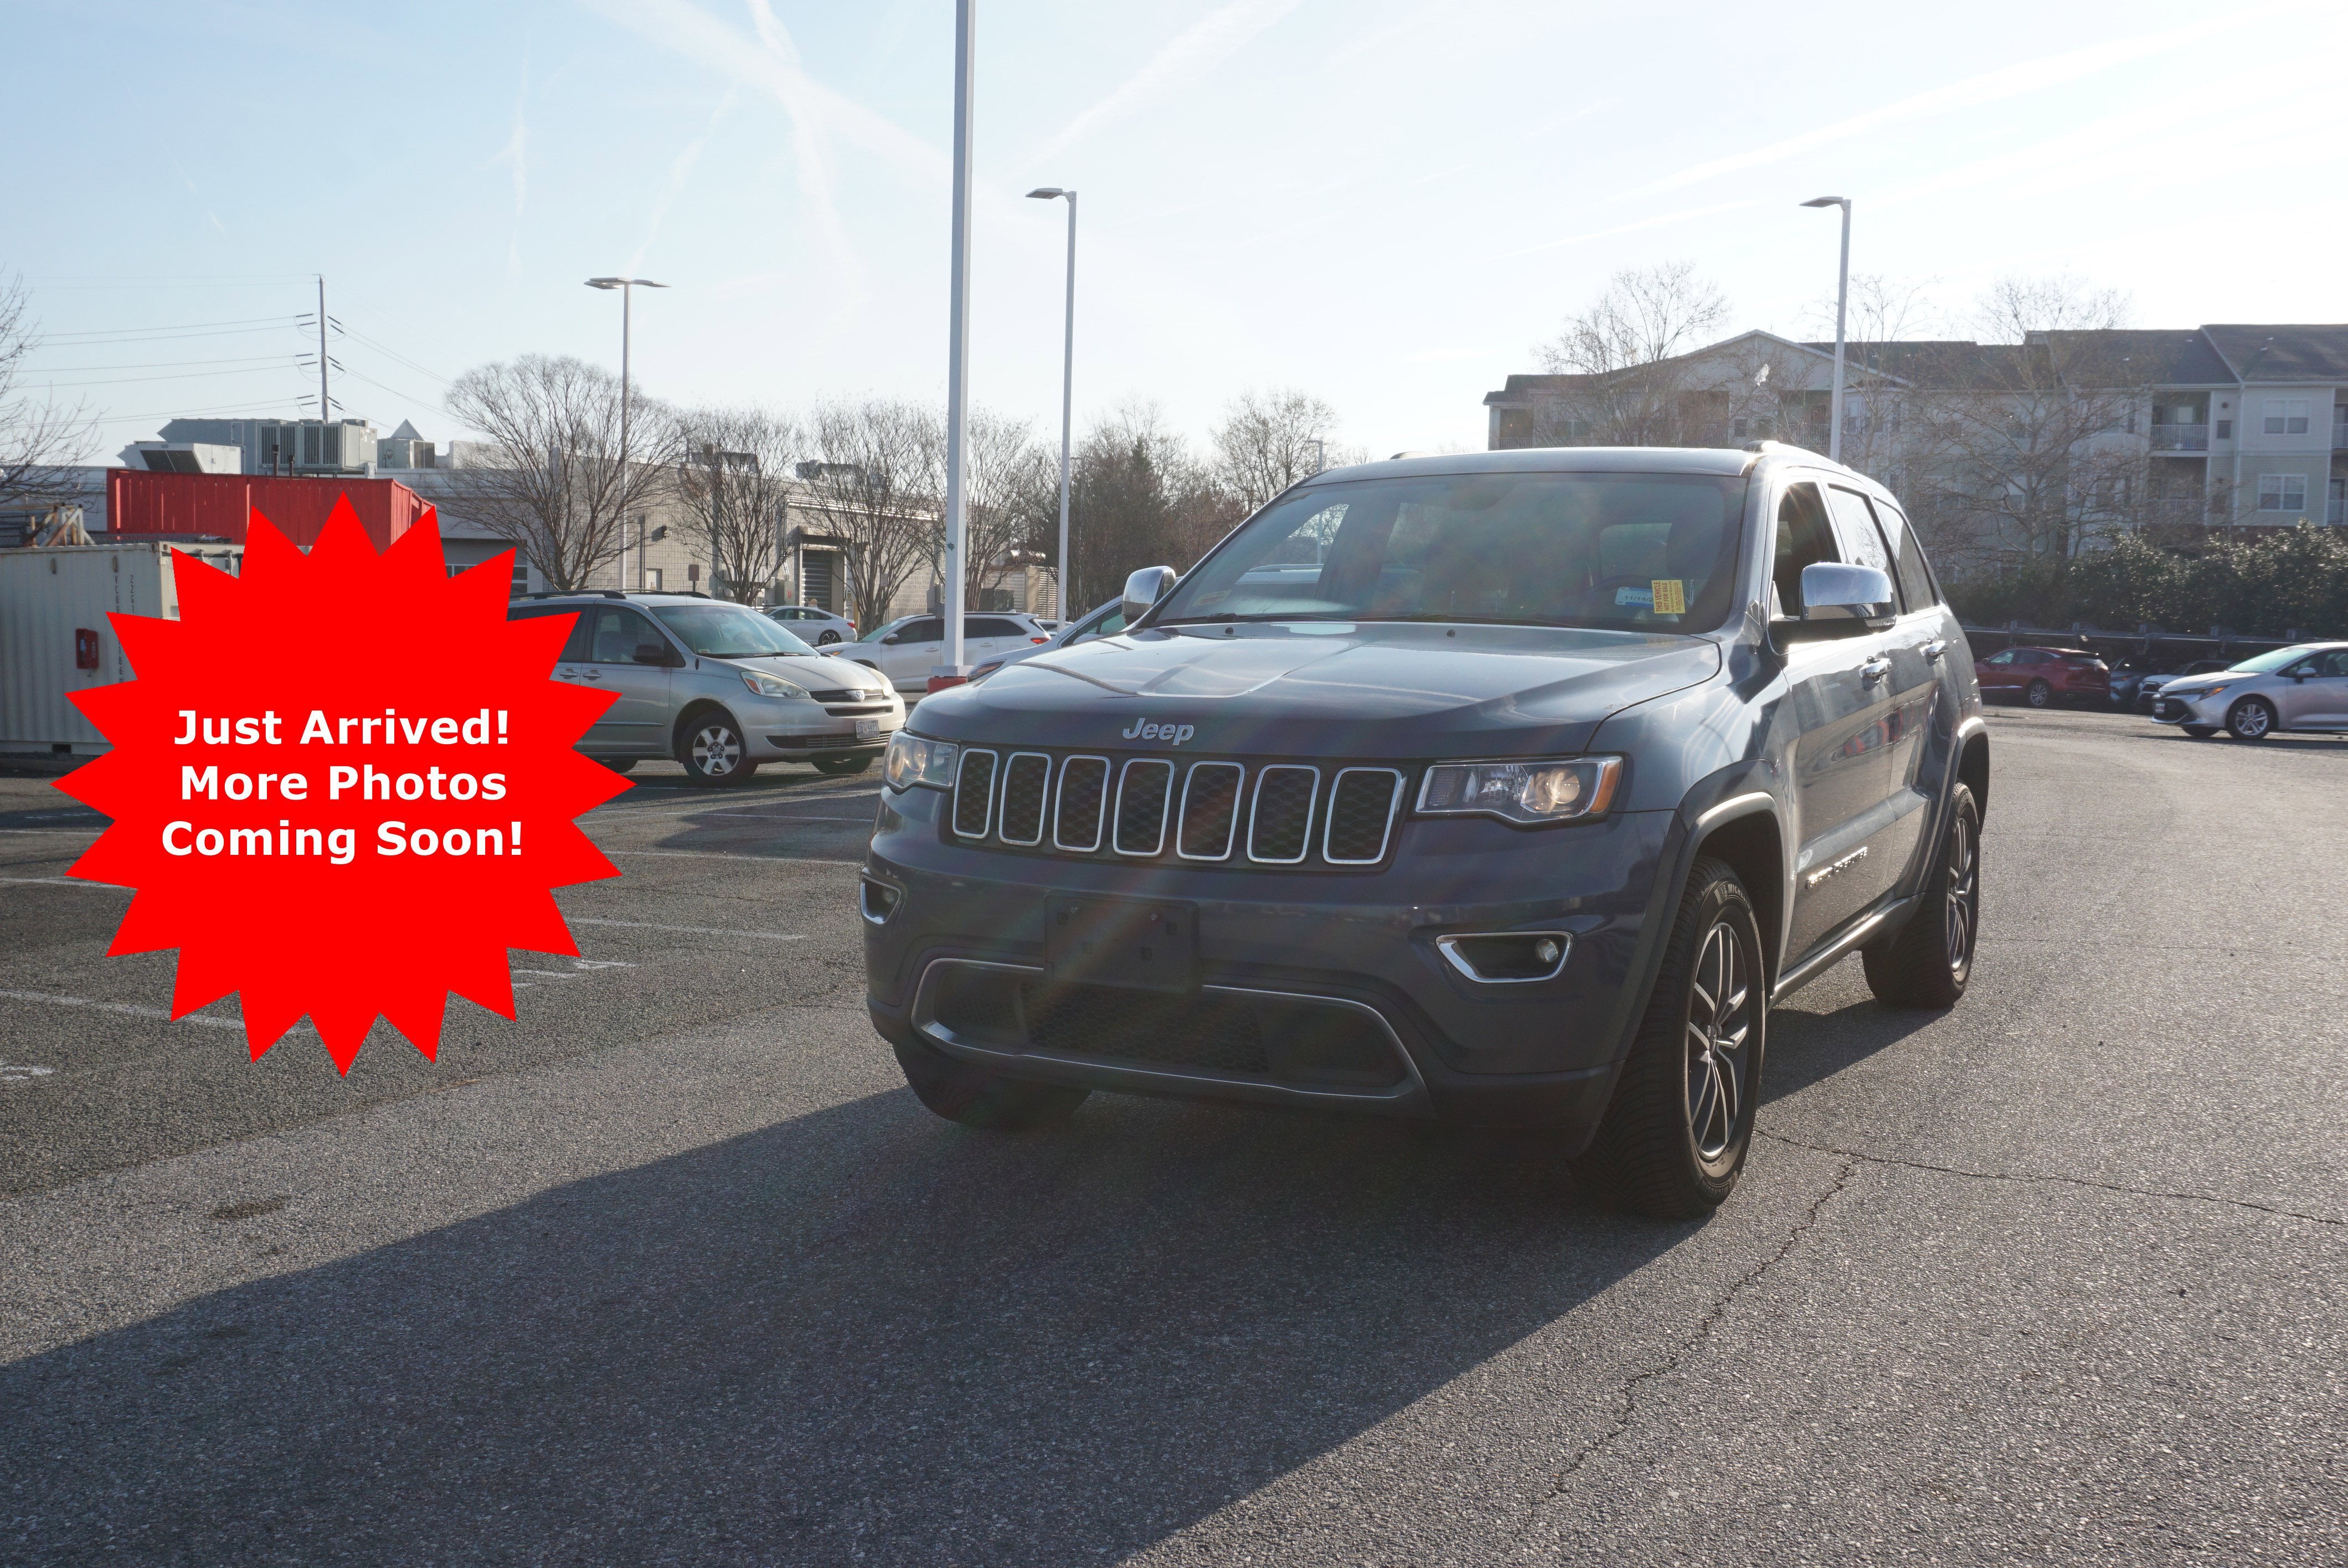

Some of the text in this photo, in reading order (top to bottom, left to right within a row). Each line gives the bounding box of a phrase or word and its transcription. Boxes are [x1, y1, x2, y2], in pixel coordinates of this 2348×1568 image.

[1654, 581, 1664, 612] THIS VEHICLE
[1122, 718, 1194, 746] Jeep
